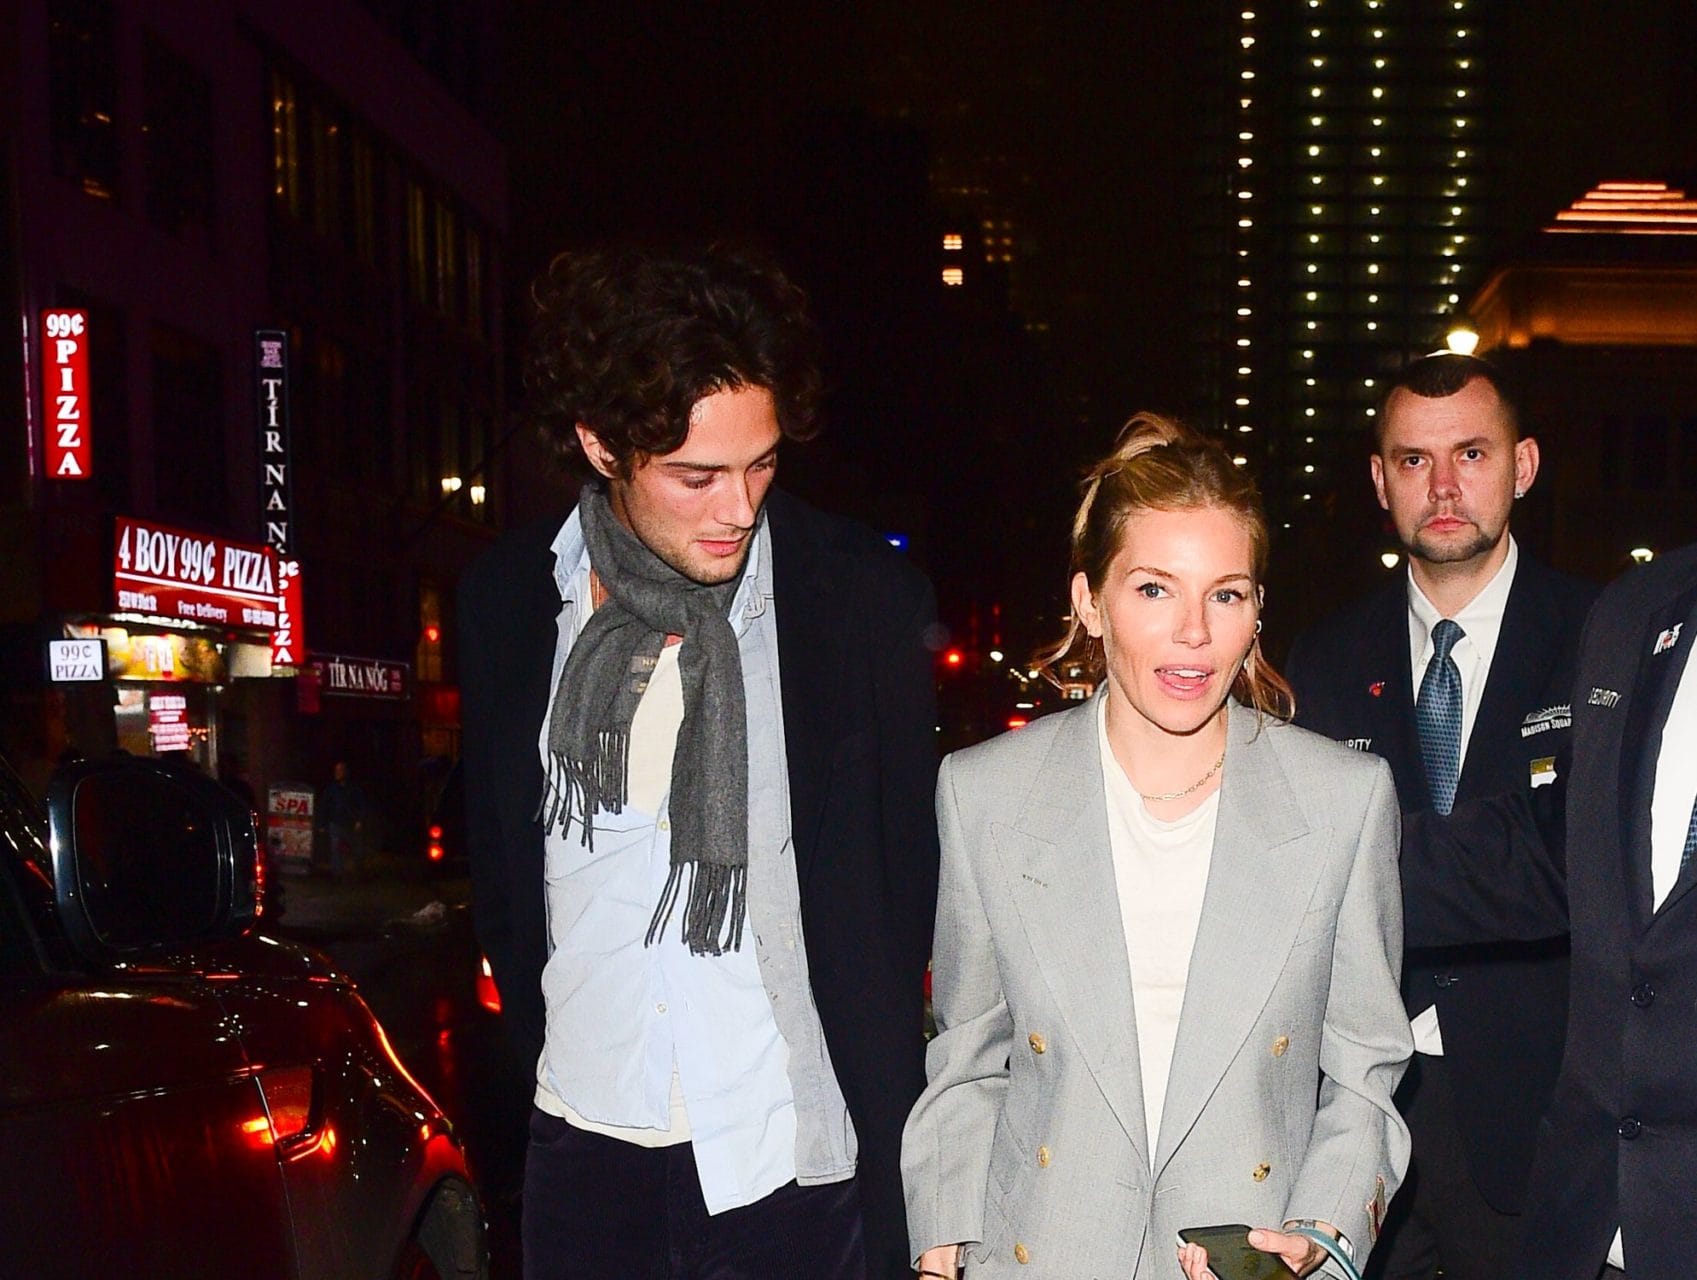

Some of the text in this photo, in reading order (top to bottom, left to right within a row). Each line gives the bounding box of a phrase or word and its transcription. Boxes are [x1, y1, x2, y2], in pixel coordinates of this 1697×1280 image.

[46, 313, 84, 338] 99¢
[55, 339, 82, 476] PIZZA
[265, 463, 286, 511] NA
[118, 525, 131, 570] 4
[134, 527, 180, 578] BOY
[179, 537, 216, 586] 99¢
[223, 546, 275, 594] PIZZA
[60, 644, 93, 662] 99¢
[55, 664, 100, 679] PIZZA
[1550, 717, 1572, 730] SQUAR
[274, 798, 309, 815] SPA
